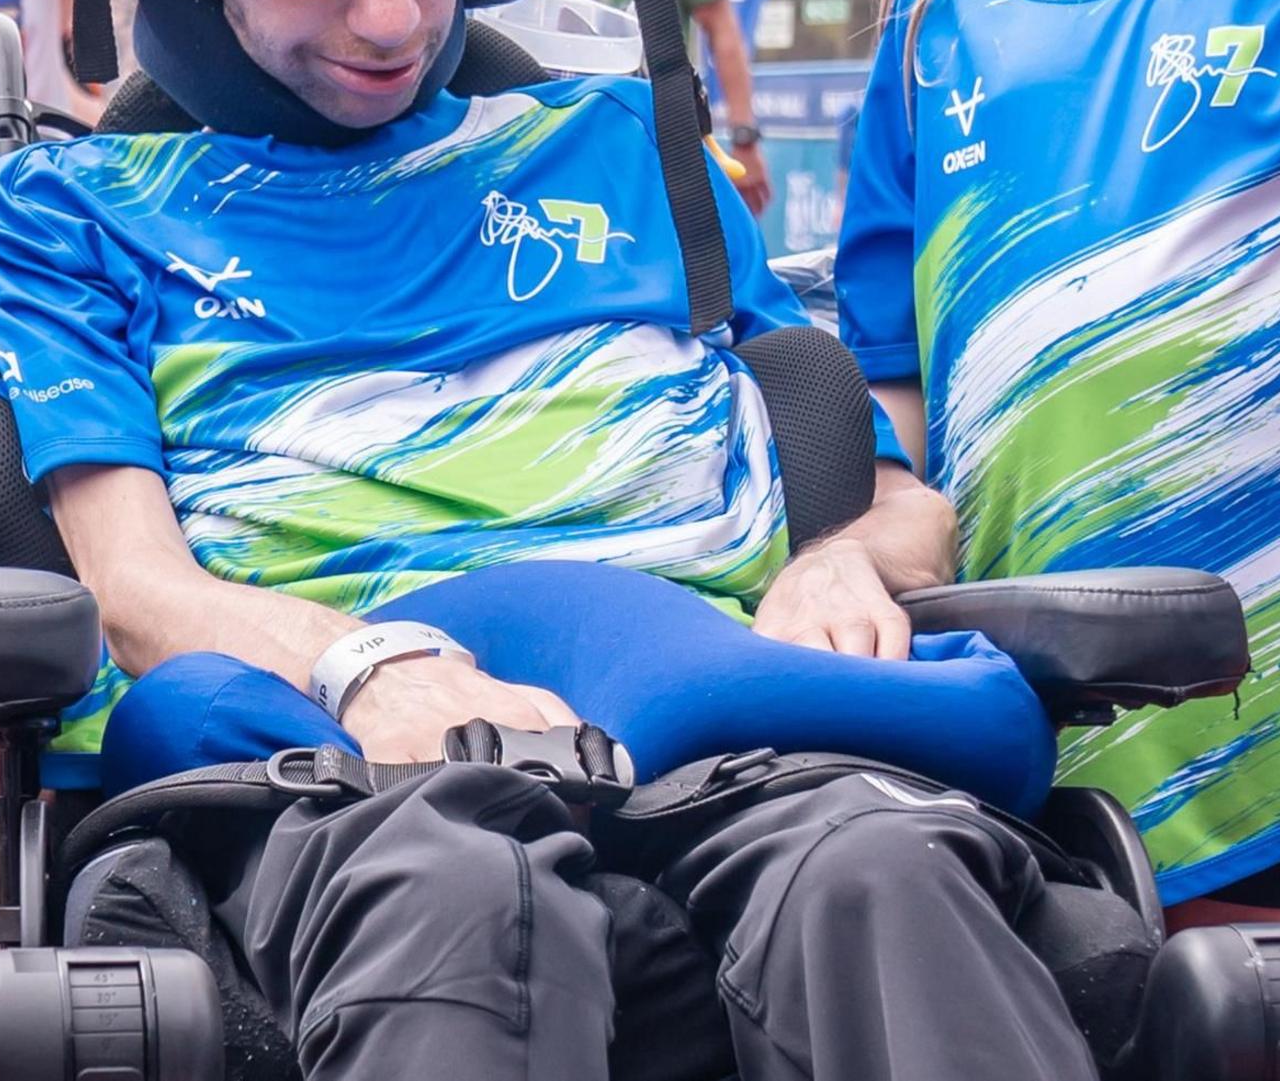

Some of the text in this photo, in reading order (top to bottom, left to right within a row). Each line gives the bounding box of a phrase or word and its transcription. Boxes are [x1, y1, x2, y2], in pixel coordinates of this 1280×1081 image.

[1204, 23, 1267, 107] 7
[942, 140, 986, 175] OXEN
[194, 296, 267, 320] OXN
[351, 636, 386, 655] VIP
[317, 684, 328, 706] IP
